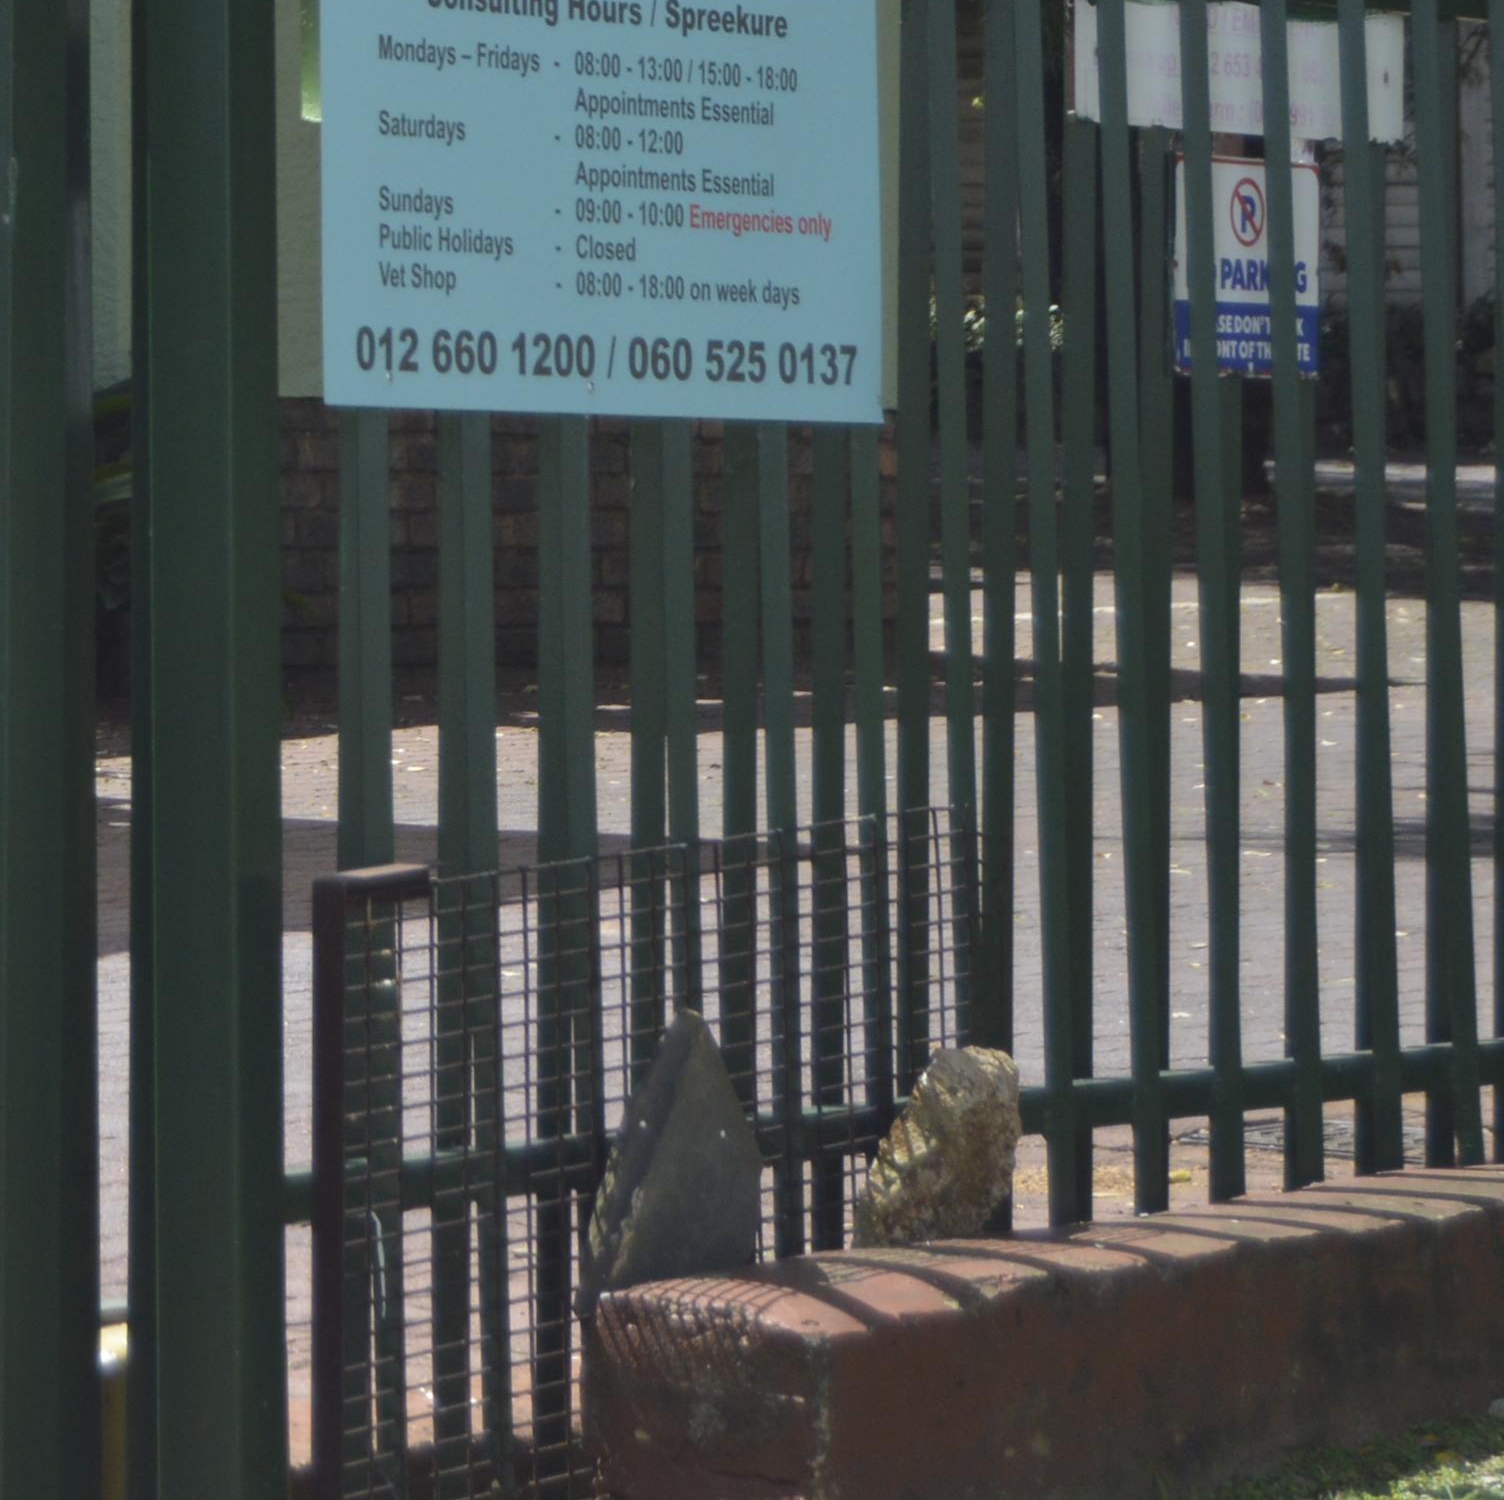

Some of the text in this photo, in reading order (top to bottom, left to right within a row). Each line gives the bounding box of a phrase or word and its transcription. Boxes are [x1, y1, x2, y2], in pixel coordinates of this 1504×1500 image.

[378, 34, 456, 68] Mondays
[477, 41, 540, 74] Fridays
[574, 50, 621, 77] 08:00
[638, 54, 682, 84] 13:00
[697, 60, 741, 88] 15:00
[757, 64, 798, 93] 18:00
[574, 87, 774, 127] Appointments Essential
[378, 111, 466, 146] Saturdays
[574, 125, 621, 152] 08:00
[638, 128, 683, 155] 12:00
[574, 161, 774, 198] Appointments Essential
[378, 186, 454, 220] Sundays
[575, 199, 621, 225] 09:00
[638, 202, 683, 228] 10:00
[689, 204, 793, 236] Emergencies
[798, 213, 832, 241] only
[379, 224, 432, 255] Public
[438, 228, 513, 259] Holidays
[575, 235, 637, 262] Closed
[379, 262, 406, 288] Vet
[411, 264, 456, 295] Shop
[576, 272, 622, 298] 08:00
[639, 274, 684, 300] 18:00
[690, 282, 711, 302] on
[716, 278, 758, 304] week
[763, 280, 800, 310] days
[1220, 257, 1308, 293] PARKG
[356, 326, 419, 372] 012
[432, 329, 497, 375] 660
[511, 333, 595, 378] 1200
[628, 338, 692, 381] 060
[705, 341, 766, 384] 525
[778, 343, 858, 386] 0137
[1238, 340, 1256, 359] OF
